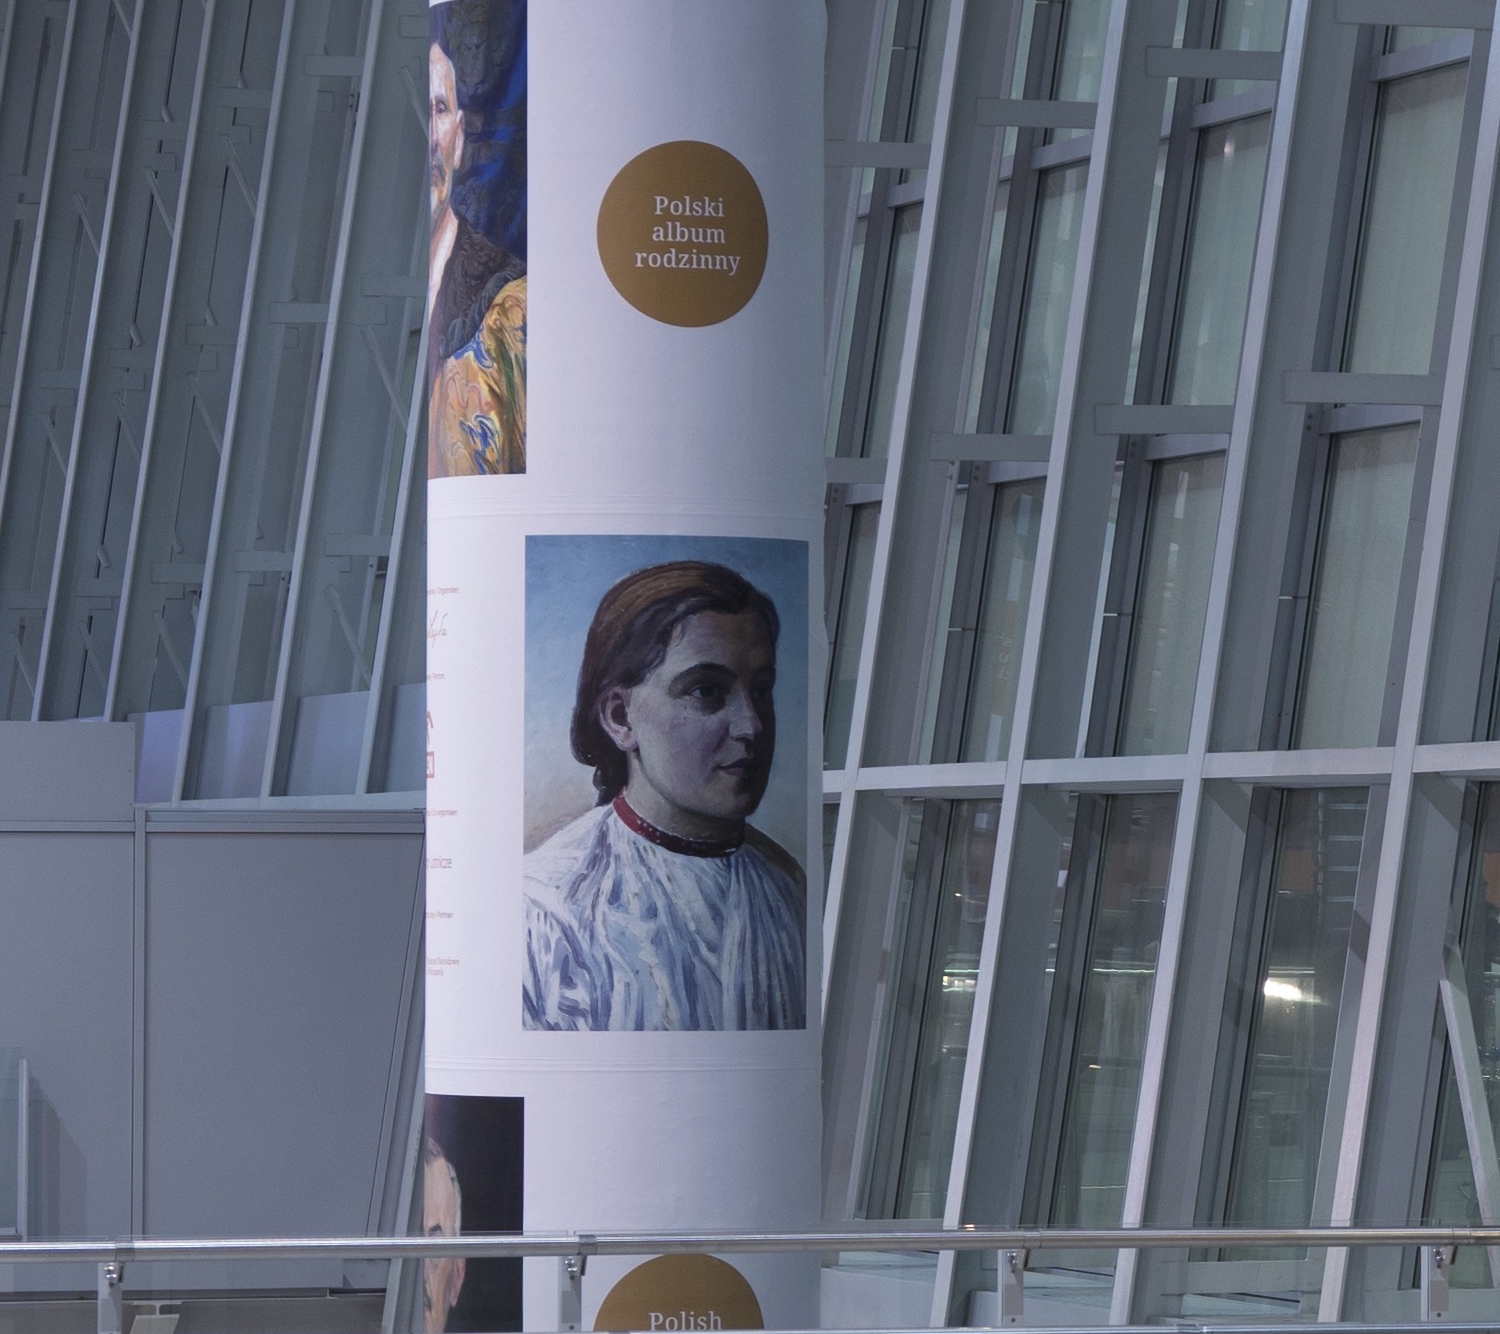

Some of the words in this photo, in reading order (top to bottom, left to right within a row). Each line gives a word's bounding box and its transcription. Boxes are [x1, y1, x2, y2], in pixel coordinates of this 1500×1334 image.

[654, 195, 725, 217] Polski
[652, 221, 726, 244] album
[634, 247, 741, 276] rodzinny
[649, 1310, 723, 1331] Polish
